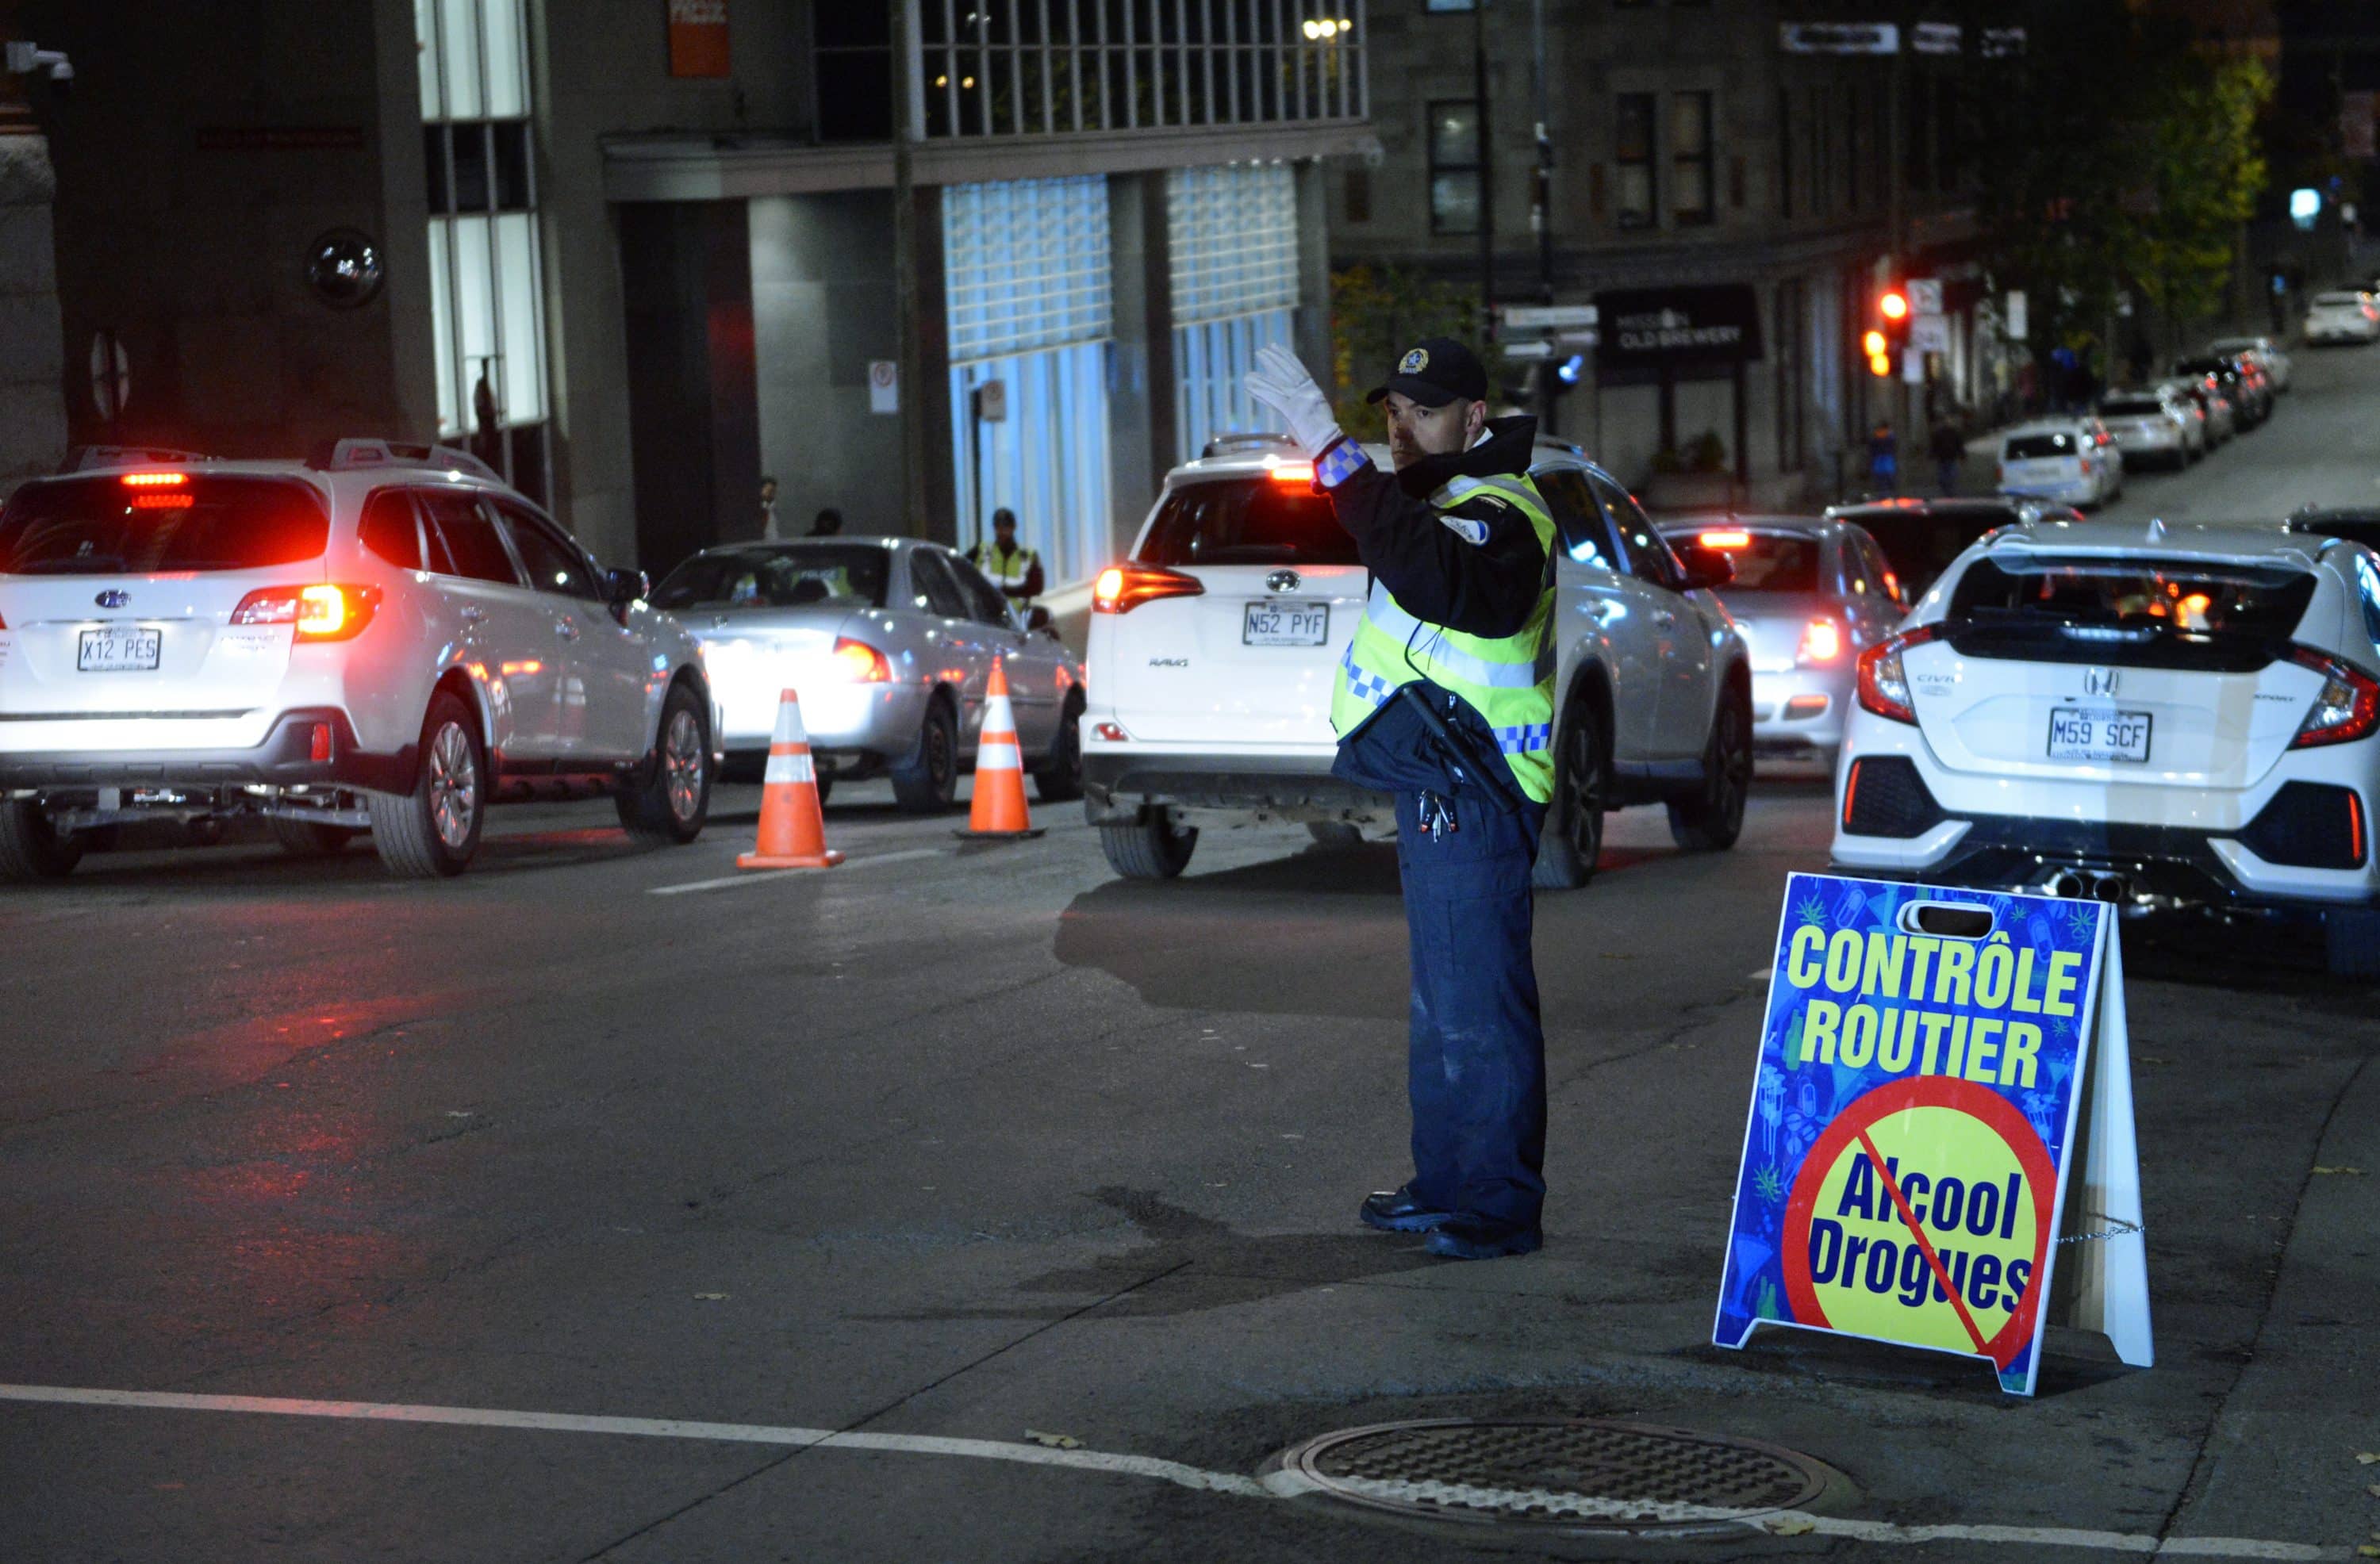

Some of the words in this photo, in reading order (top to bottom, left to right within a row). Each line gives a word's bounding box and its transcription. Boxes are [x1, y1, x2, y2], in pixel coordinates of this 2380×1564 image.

[1619, 329, 1656, 350] OLD
[1660, 325, 1741, 347] BREWERY
[83, 638, 114, 660] X12
[125, 638, 156, 660] PES
[1248, 613, 1280, 634] N52
[1292, 613, 1324, 634] PYF
[2052, 719, 2093, 745] M59
[2105, 723, 2145, 748] SCF
[1787, 924, 2082, 1018] CONTRÔLE
[1798, 998, 2043, 1090] ROUTIER
[1837, 1152, 2022, 1240] Alcool
[1808, 1217, 2033, 1314] Drogues
